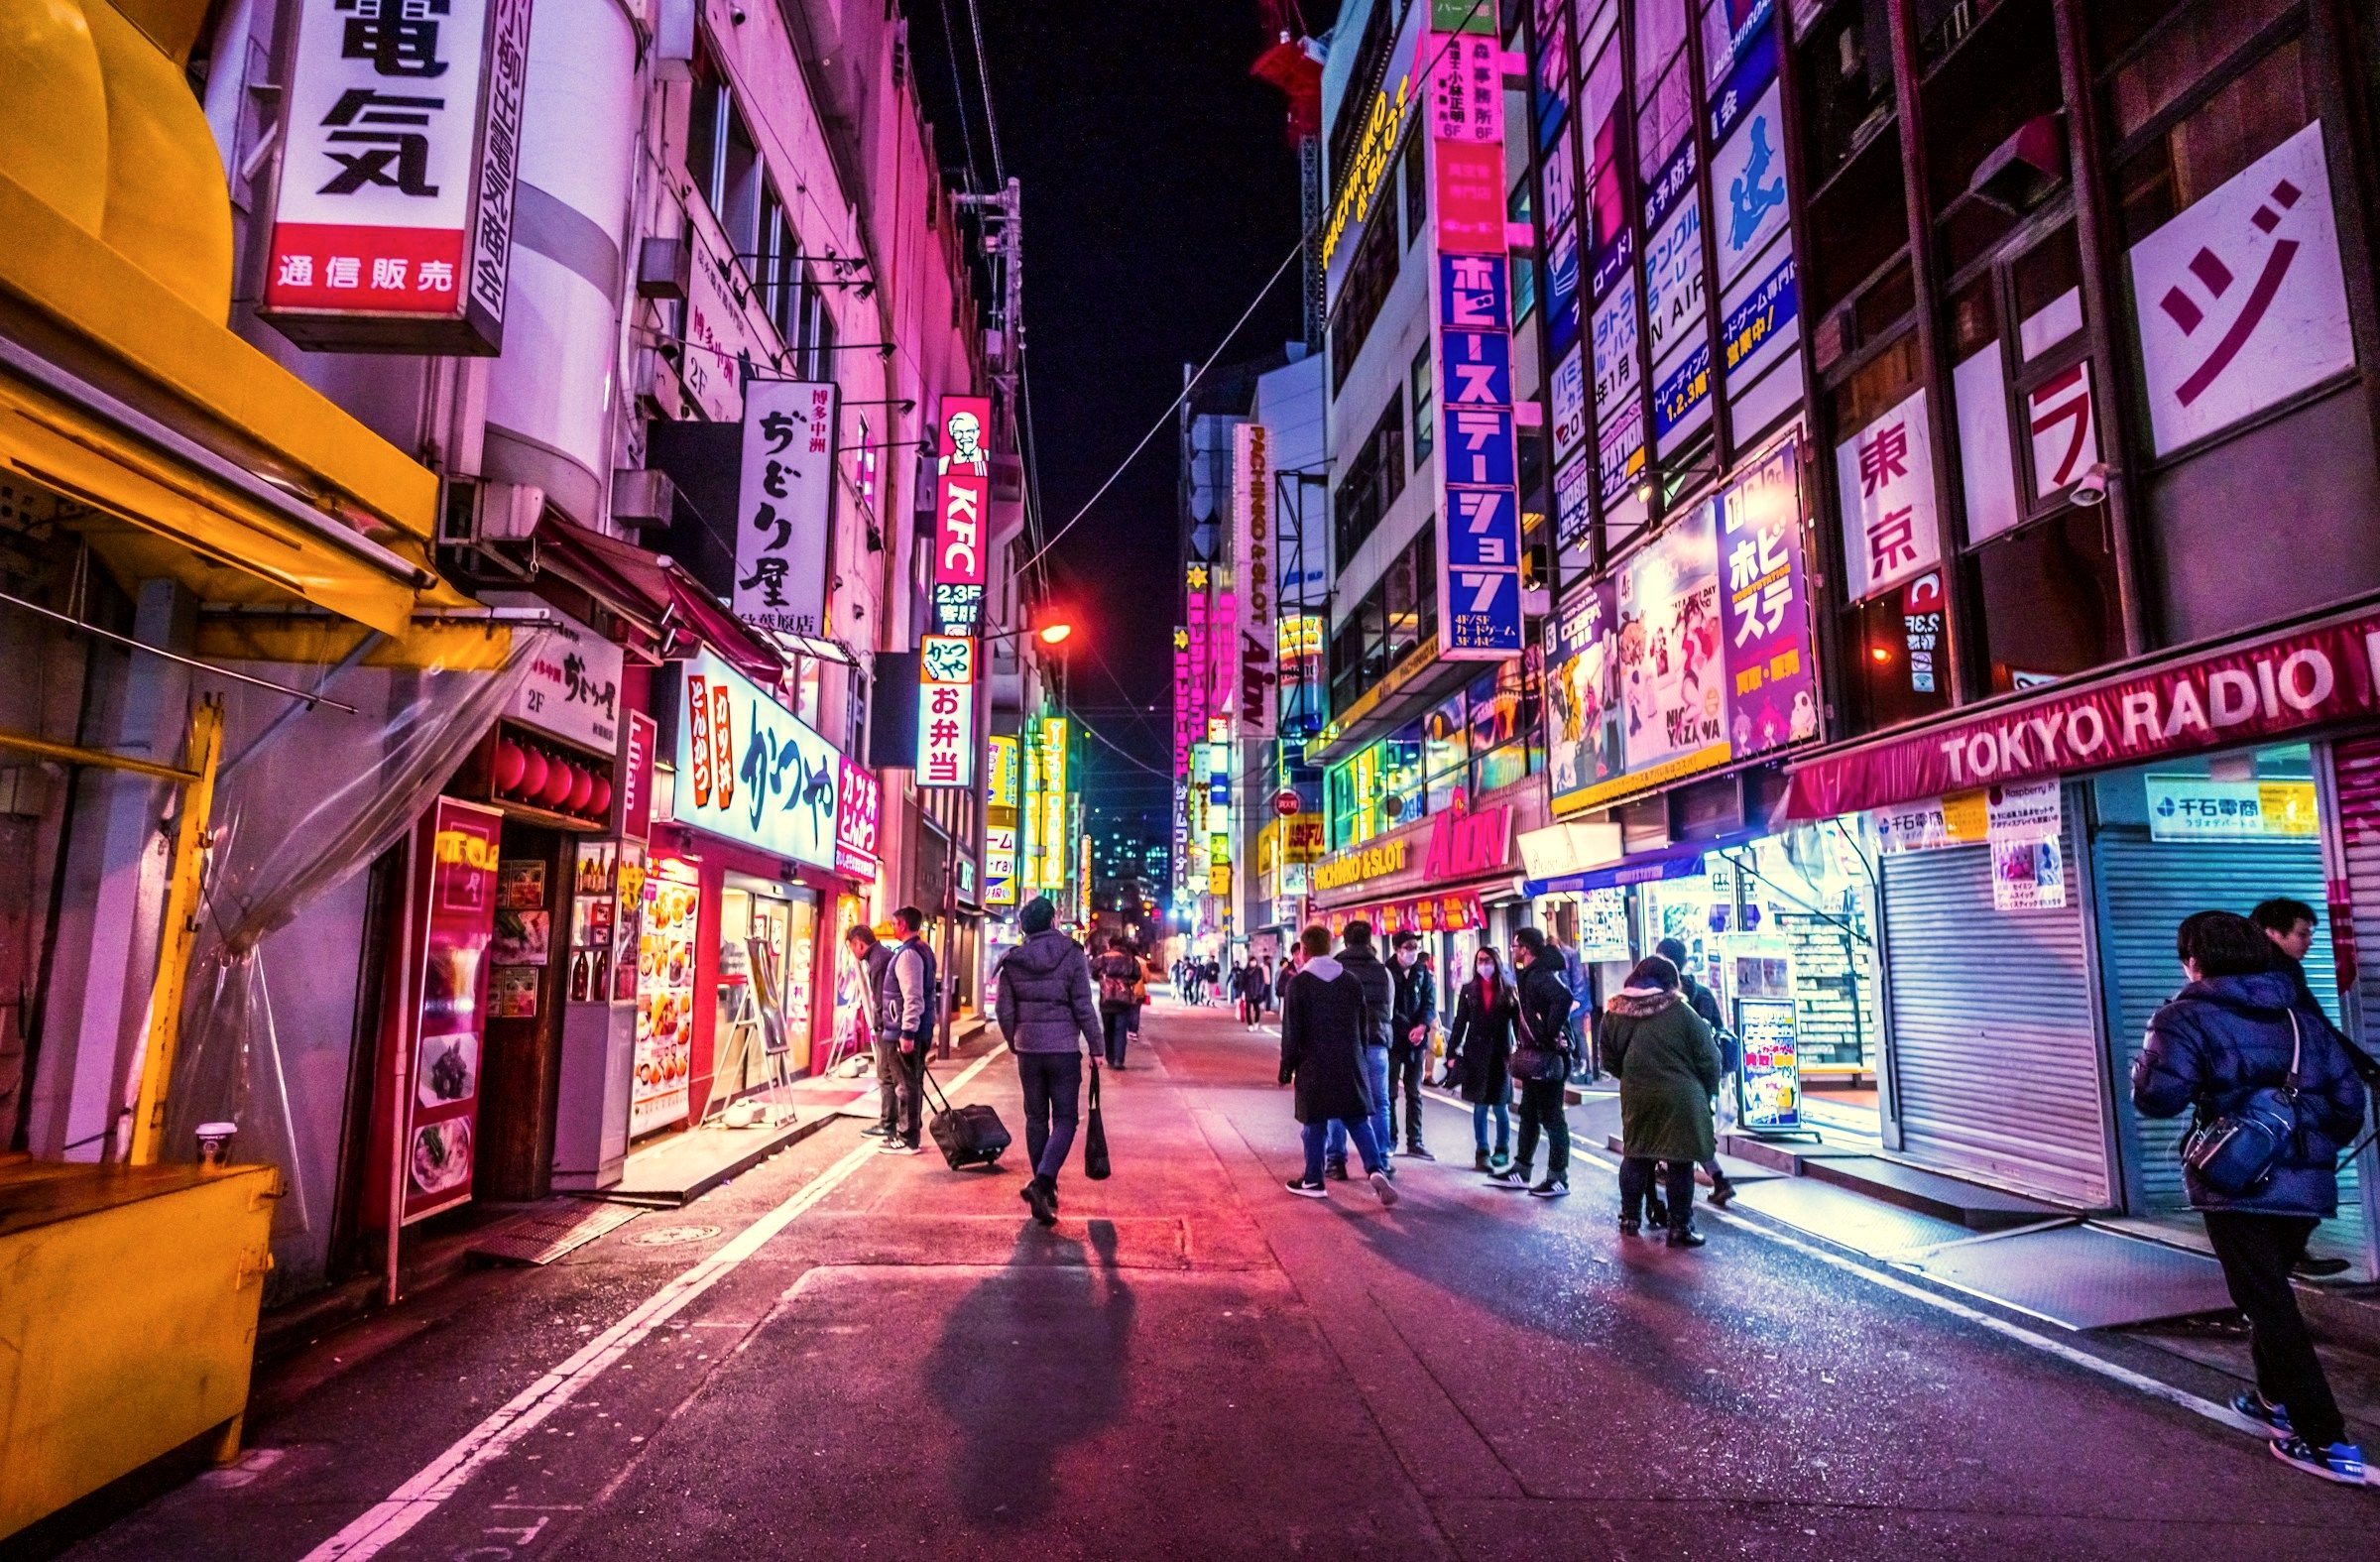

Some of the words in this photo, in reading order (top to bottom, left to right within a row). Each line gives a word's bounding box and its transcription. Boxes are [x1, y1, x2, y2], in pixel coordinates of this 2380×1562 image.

[315, 0, 451, 196] 電気
[1323, 90, 1386, 270] PACHINKO
[277, 255, 453, 292] 通信販売
[2159, 179, 2303, 409] ジ
[809, 390, 827, 453] 博多中洲
[1451, 258, 1506, 612] ホビーステーション
[2032, 362, 2090, 486] ラ
[739, 411, 807, 607] ぢどり屋
[944, 482, 978, 577] KFC
[1250, 426, 1265, 541] PACHINKO
[1858, 421, 1918, 582] 東京
[1728, 523, 1789, 592] ホビ
[924, 641, 967, 679] かつや
[1733, 575, 1794, 650] ステ
[528, 688, 545, 713] 2F
[691, 681, 709, 791] とんかつ
[928, 686, 960, 782] お弁当
[1940, 708, 2106, 783] TOKYO
[2121, 648, 2335, 747] RADIO
[740, 699, 834, 852] かつや
[843, 764, 878, 821] カツ丼
[2005, 784, 2047, 798] Raspberry
[2048, 781, 2057, 792] Pi
[2179, 797, 2258, 817] 千石電商
[841, 808, 876, 852] とんかつ
[987, 833, 1012, 849] ーム
[1314, 854, 1362, 891] PACHINKO
[1424, 784, 1511, 882] AiON
